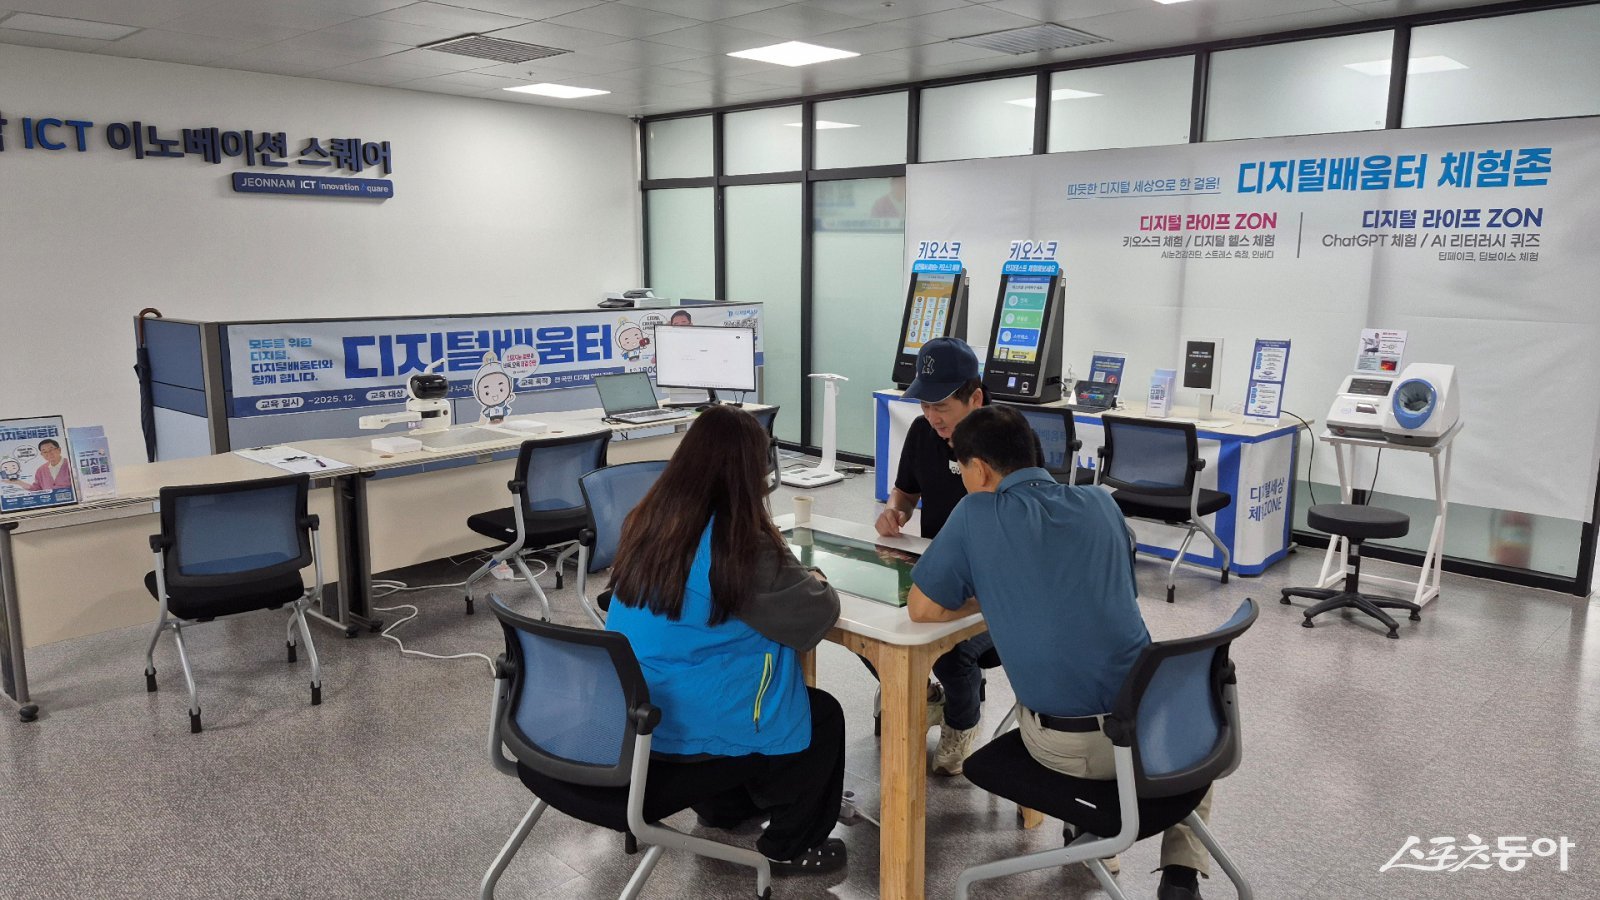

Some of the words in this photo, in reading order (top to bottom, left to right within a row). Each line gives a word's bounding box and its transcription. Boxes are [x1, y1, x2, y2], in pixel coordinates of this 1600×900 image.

[22, 117, 94, 152] ICT
[106, 121, 289, 167] 이노베이션
[298, 137, 392, 174] 스퀘어
[1237, 154, 1428, 194] 디지털배움터
[1437, 147, 1552, 188] 체험존
[241, 177, 296, 188] JEONNAM
[300, 180, 316, 189] ICT
[1100, 181, 1131, 195] 디지털
[1133, 179, 1176, 193] 세상으로
[1179, 179, 1191, 191] 한
[1193, 176, 1221, 191] 걸음!
[1139, 215, 1182, 232] 디지털
[1186, 213, 1231, 231] 라이프
[1235, 212, 1278, 230] ZON
[1362, 210, 1417, 229] 디지털
[1423, 209, 1481, 229] 라이프
[1486, 208, 1544, 228] ZON
[1122, 237, 1161, 248] 키오스크
[1163, 237, 1183, 248] 체험
[1194, 235, 1226, 248] 디지털
[1228, 235, 1250, 247] 헬스
[1252, 234, 1275, 247] 체험
[1322, 234, 1389, 248] ChatGPT
[1391, 233, 1417, 248] 체험
[1431, 233, 1447, 247] AI
[1450, 233, 1506, 248] 리터러시
[1510, 233, 1540, 248] 퀴즈
[919, 242, 960, 259] 키오스크
[1010, 242, 1057, 260] 키오스크
[1205, 250, 1232, 259] 스트레스
[1252, 250, 1274, 259] 인바디
[1438, 252, 1476, 262] 딥페이크,
[1478, 252, 1516, 262] 딥보이스
[1518, 251, 1539, 261] 체험
[249, 339, 286, 349] 모두를
[288, 338, 312, 348] 위한
[251, 360, 333, 373] 디지털배움터와
[252, 375, 276, 385] 함께
[280, 372, 318, 384] 합니다.
[388, 390, 404, 398] 대상
[281, 399, 299, 407] 일시
